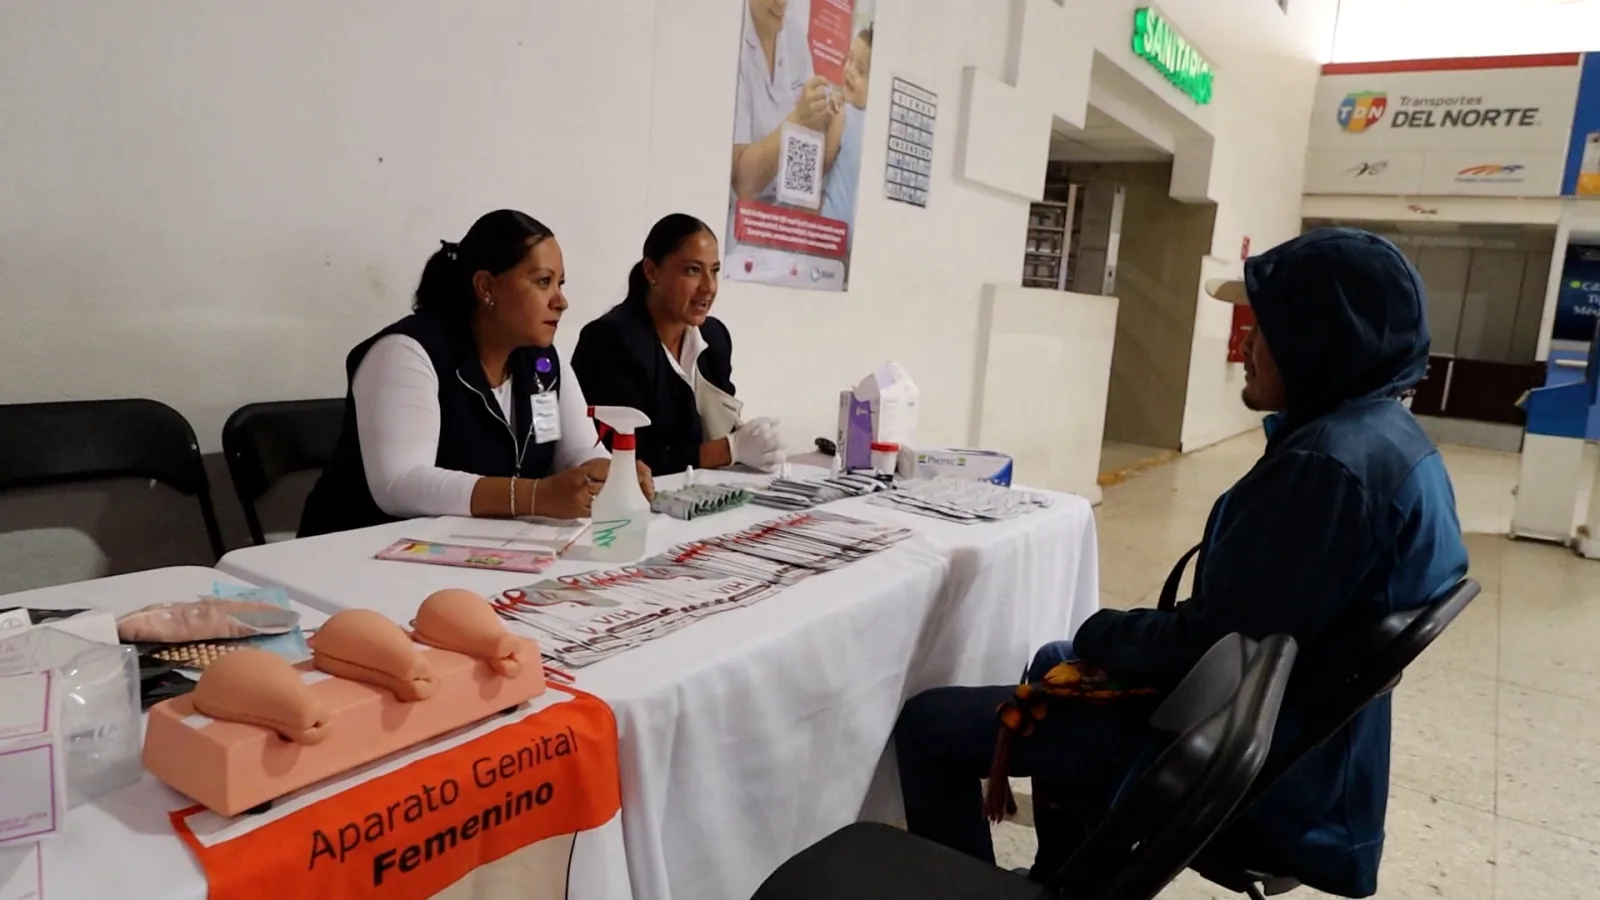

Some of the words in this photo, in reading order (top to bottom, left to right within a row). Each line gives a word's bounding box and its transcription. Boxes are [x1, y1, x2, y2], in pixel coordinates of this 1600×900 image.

[1133, 7, 1214, 104] SANITARIOS
[1399, 95, 1483, 109] Transportes
[1338, 105, 1384, 120] TDN
[1390, 110, 1437, 128] DEL
[1440, 107, 1538, 127] NORTE
[712, 581, 750, 595] VIH
[591, 608, 640, 626] VIH
[308, 775, 460, 869] Aparato
[472, 725, 579, 788] Genital
[372, 780, 555, 886] Femenino
